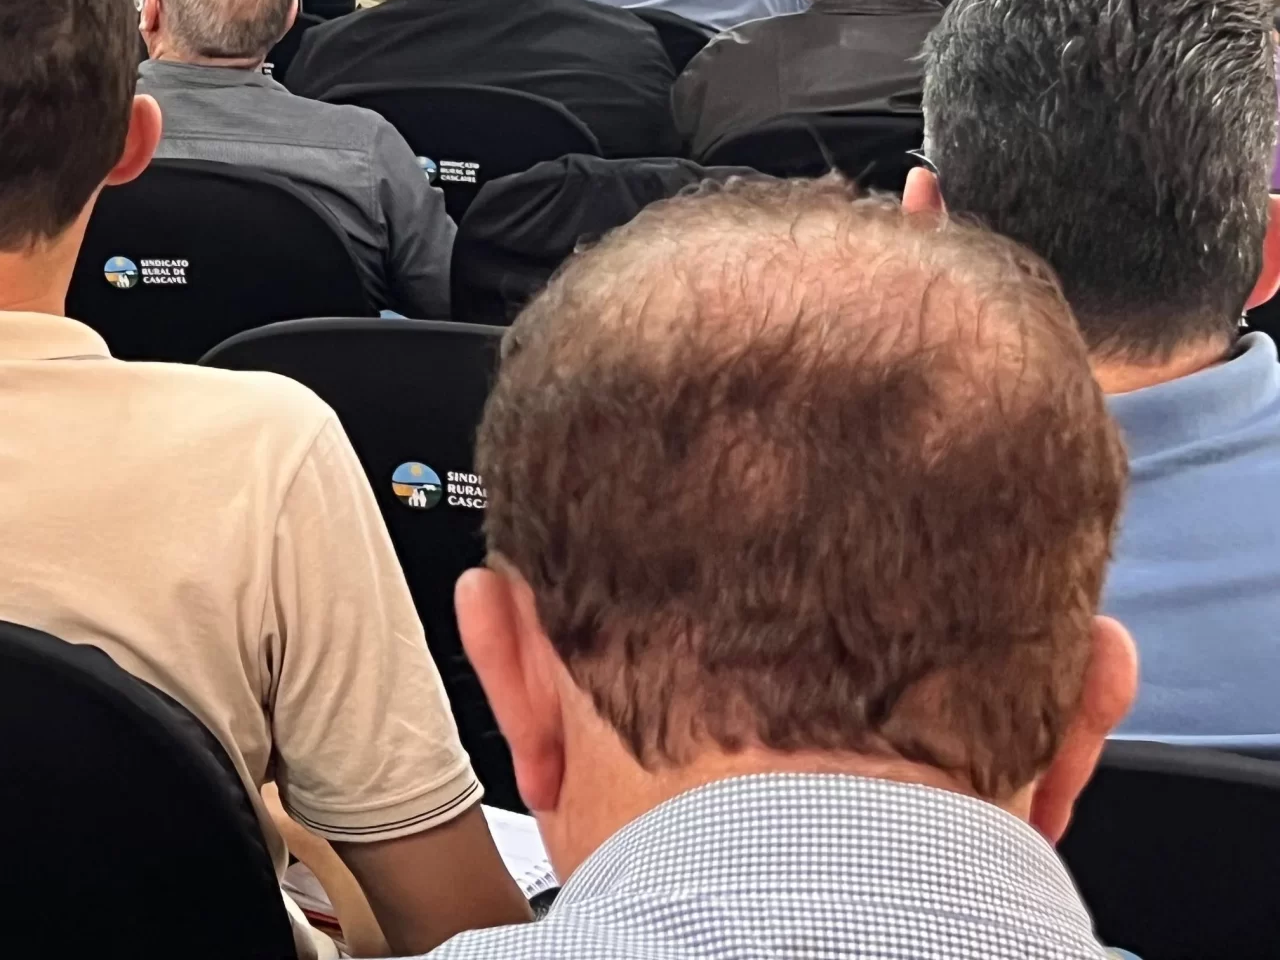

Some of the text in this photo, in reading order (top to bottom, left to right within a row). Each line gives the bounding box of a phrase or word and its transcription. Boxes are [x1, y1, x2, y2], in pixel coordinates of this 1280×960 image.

[140, 259, 189, 268] SINDICATO
[141, 268, 171, 276] RURAL
[143, 276, 187, 284] CASCAVEL
[447, 471, 482, 485] SINDI
[448, 495, 487, 509] CASC
